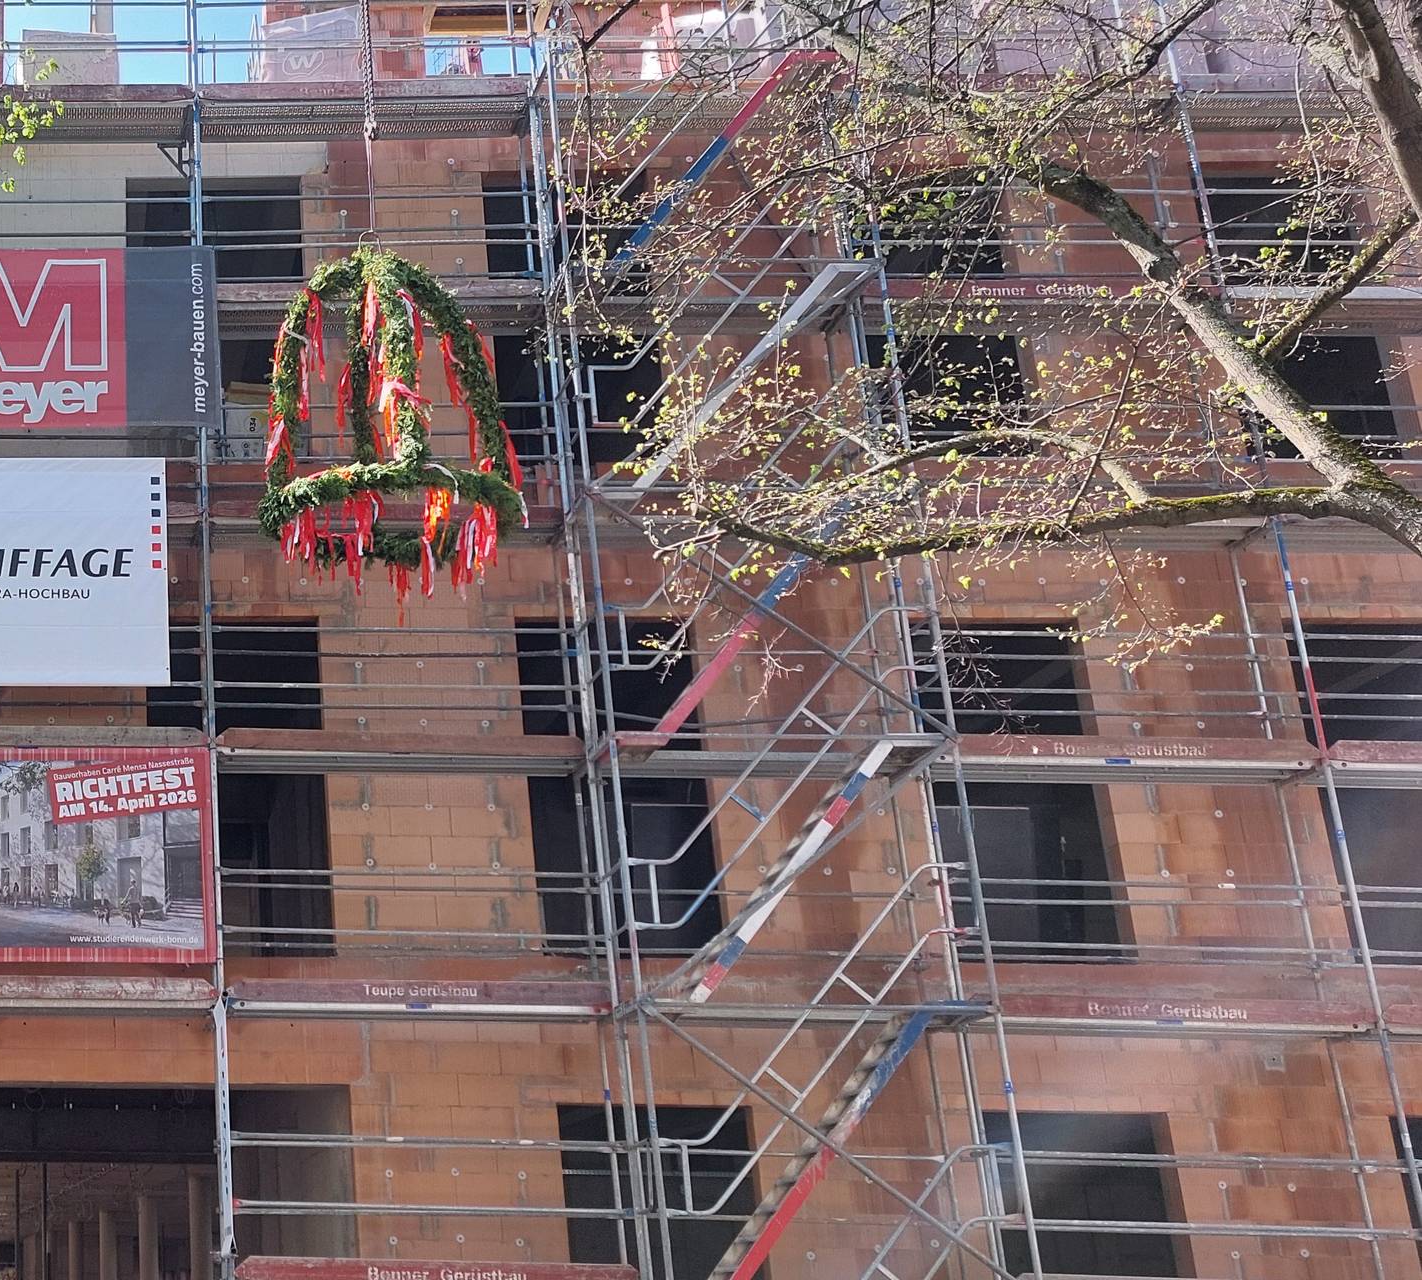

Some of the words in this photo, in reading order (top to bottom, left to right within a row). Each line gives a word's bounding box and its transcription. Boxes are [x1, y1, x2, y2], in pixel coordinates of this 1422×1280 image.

[190, 263, 209, 413] meyer-bauen.com
[53, 770, 101, 781] Bauvorhaben
[102, 765, 122, 775] Carré
[123, 763, 148, 773] Mensa
[149, 757, 195, 769] Nassestraße
[55, 766, 196, 803] RICHTFEST
[58, 802, 86, 818] AM
[89, 800, 114, 814] 14.
[117, 794, 156, 813] April
[158, 790, 197, 806] 2026
[69, 934, 199, 945] www.studierendenwerk-bonn.de
[363, 983, 405, 999] Teupe
[1161, 1002, 1248, 1020] Gerüstbau
[368, 1266, 429, 1280] Bonner
